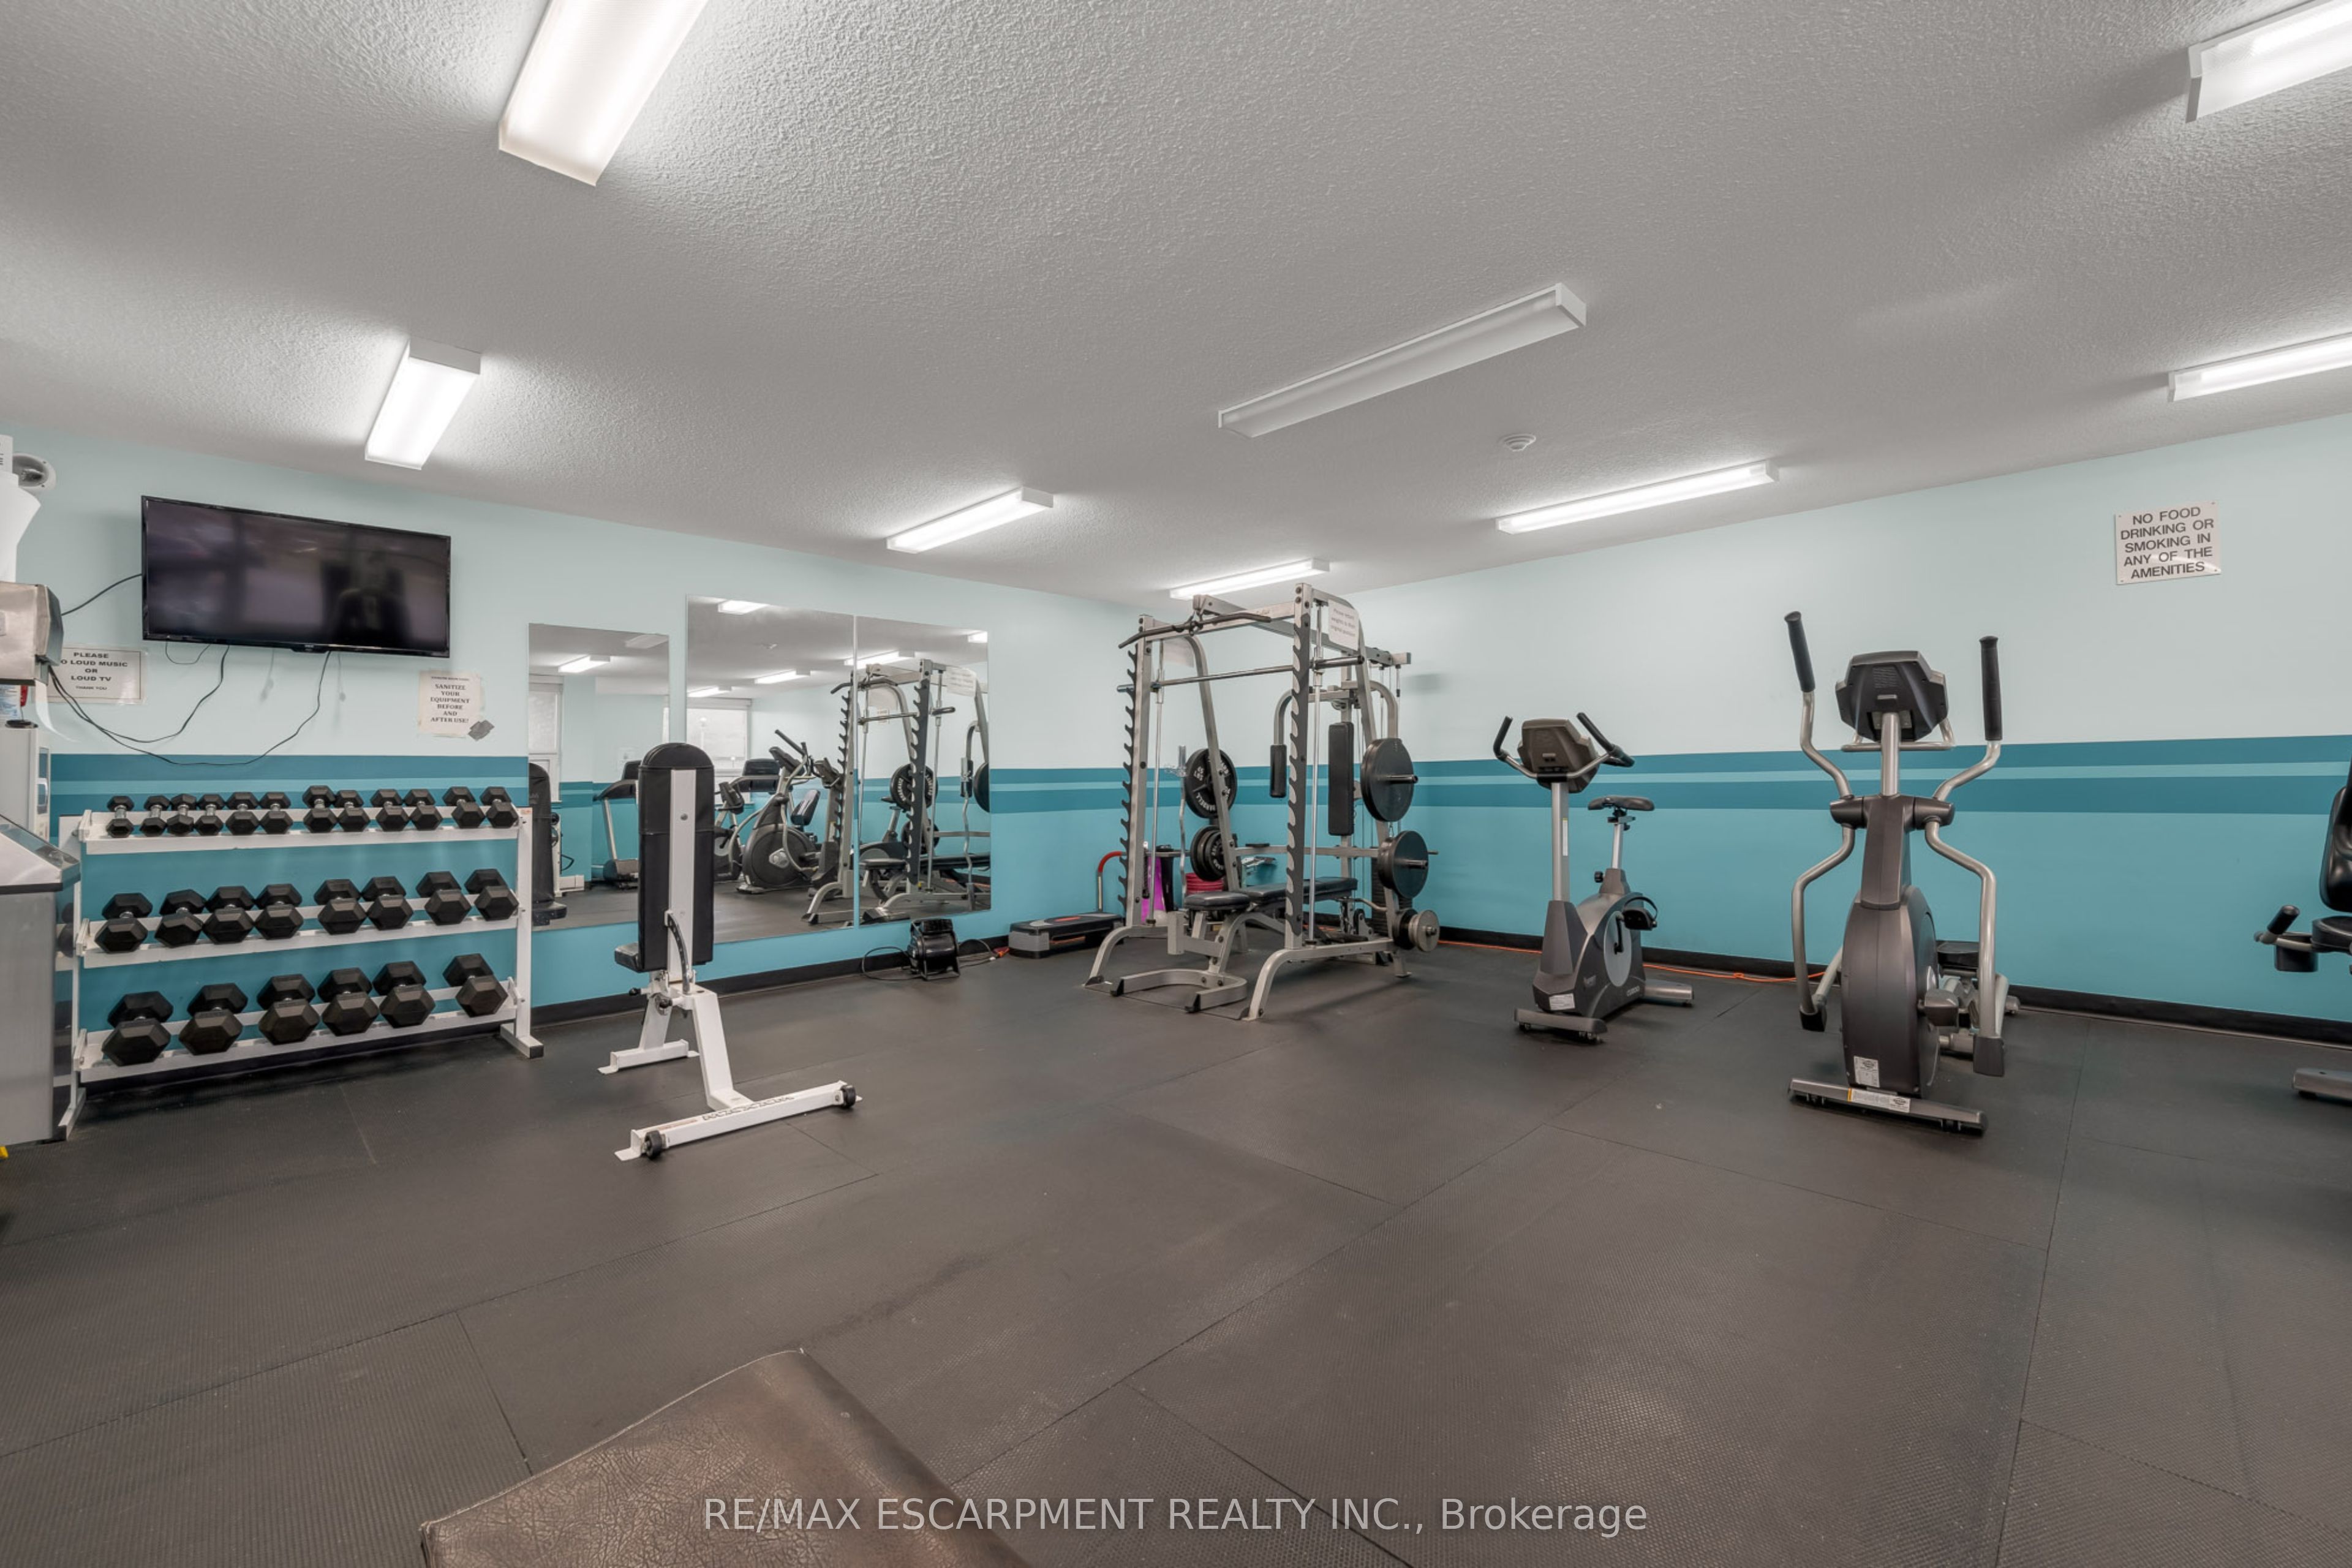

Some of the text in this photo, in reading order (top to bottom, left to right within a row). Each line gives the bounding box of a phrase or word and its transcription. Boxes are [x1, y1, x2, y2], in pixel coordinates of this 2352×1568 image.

[2133, 507, 2201, 525] NO FOOD
[2120, 519, 2214, 540] DRINKING OR
[2125, 533, 2211, 552] SMOKING IN
[2124, 546, 2213, 567] ANY OF THE
[2131, 561, 2205, 579] AMENITIES
